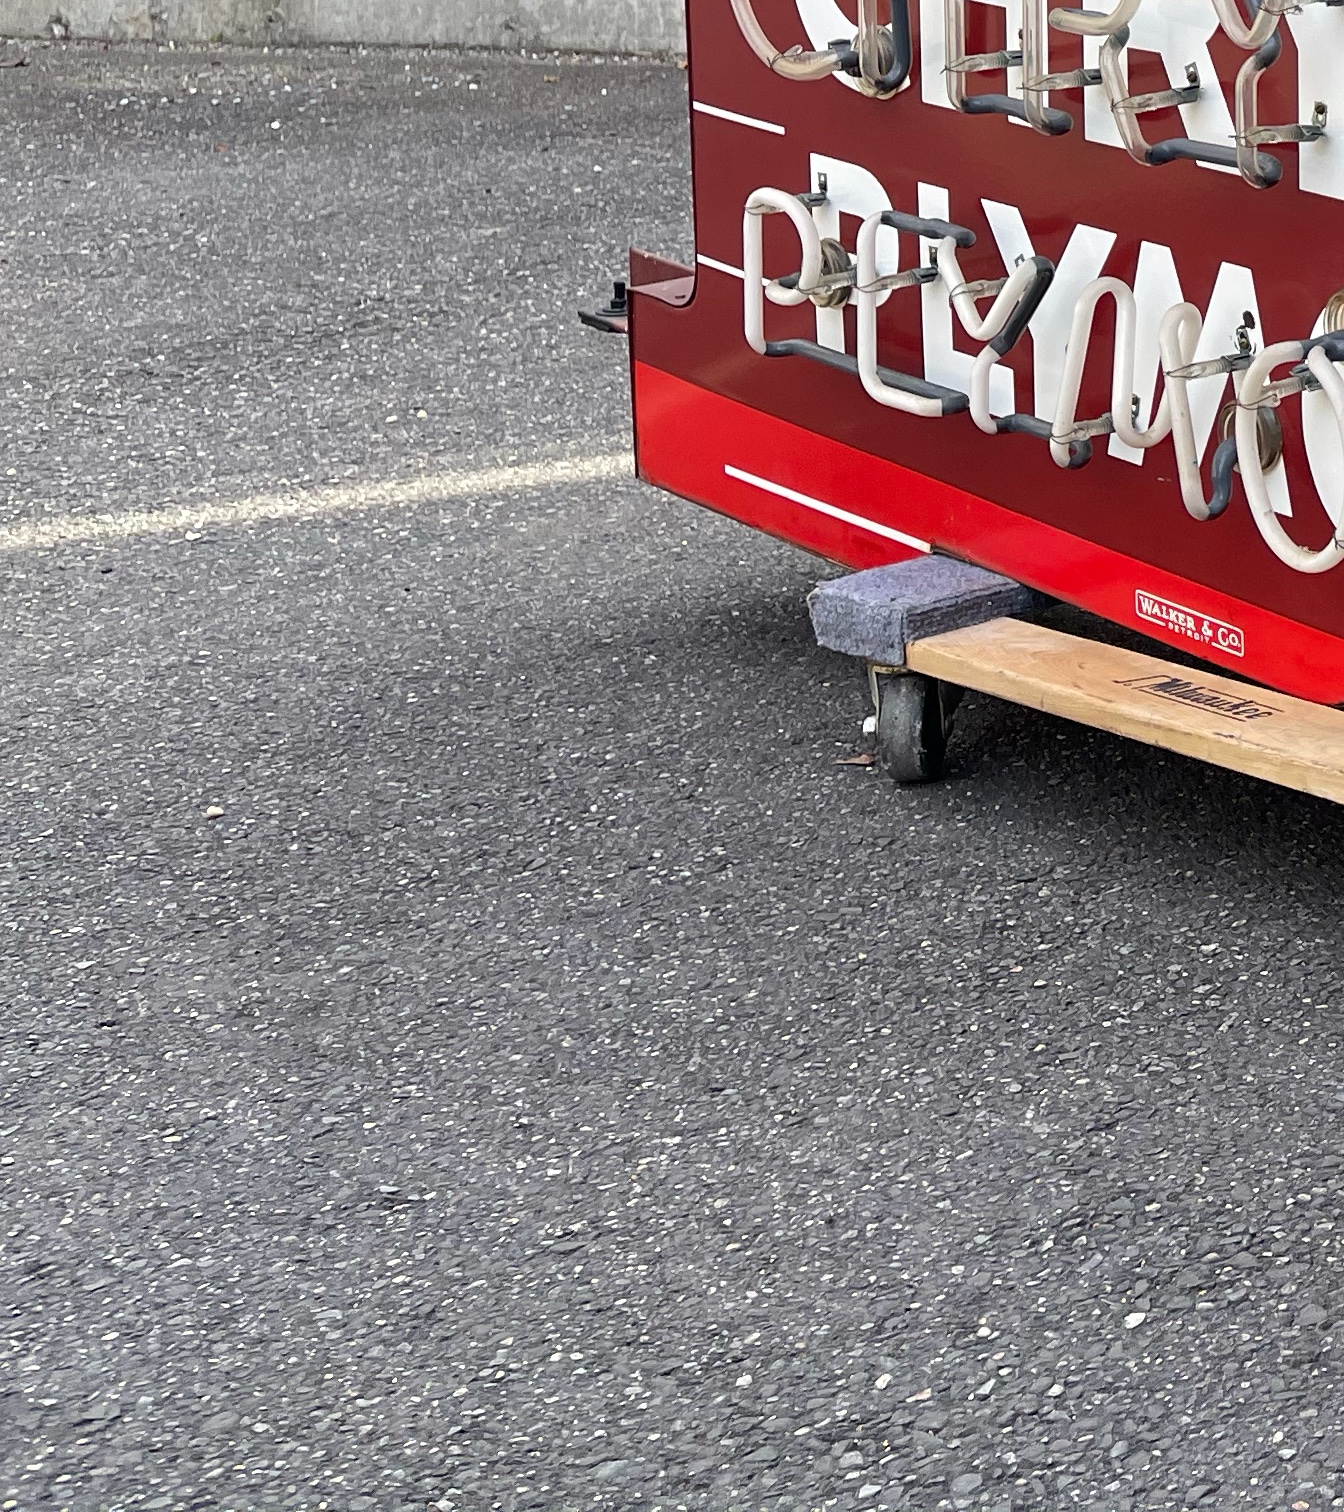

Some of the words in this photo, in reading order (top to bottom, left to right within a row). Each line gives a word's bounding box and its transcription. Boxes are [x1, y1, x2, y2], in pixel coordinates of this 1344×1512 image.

[1138, 595, 1196, 632] WALKER
[1201, 620, 1214, 638] &
[1168, 621, 1210, 644] DETROIT
